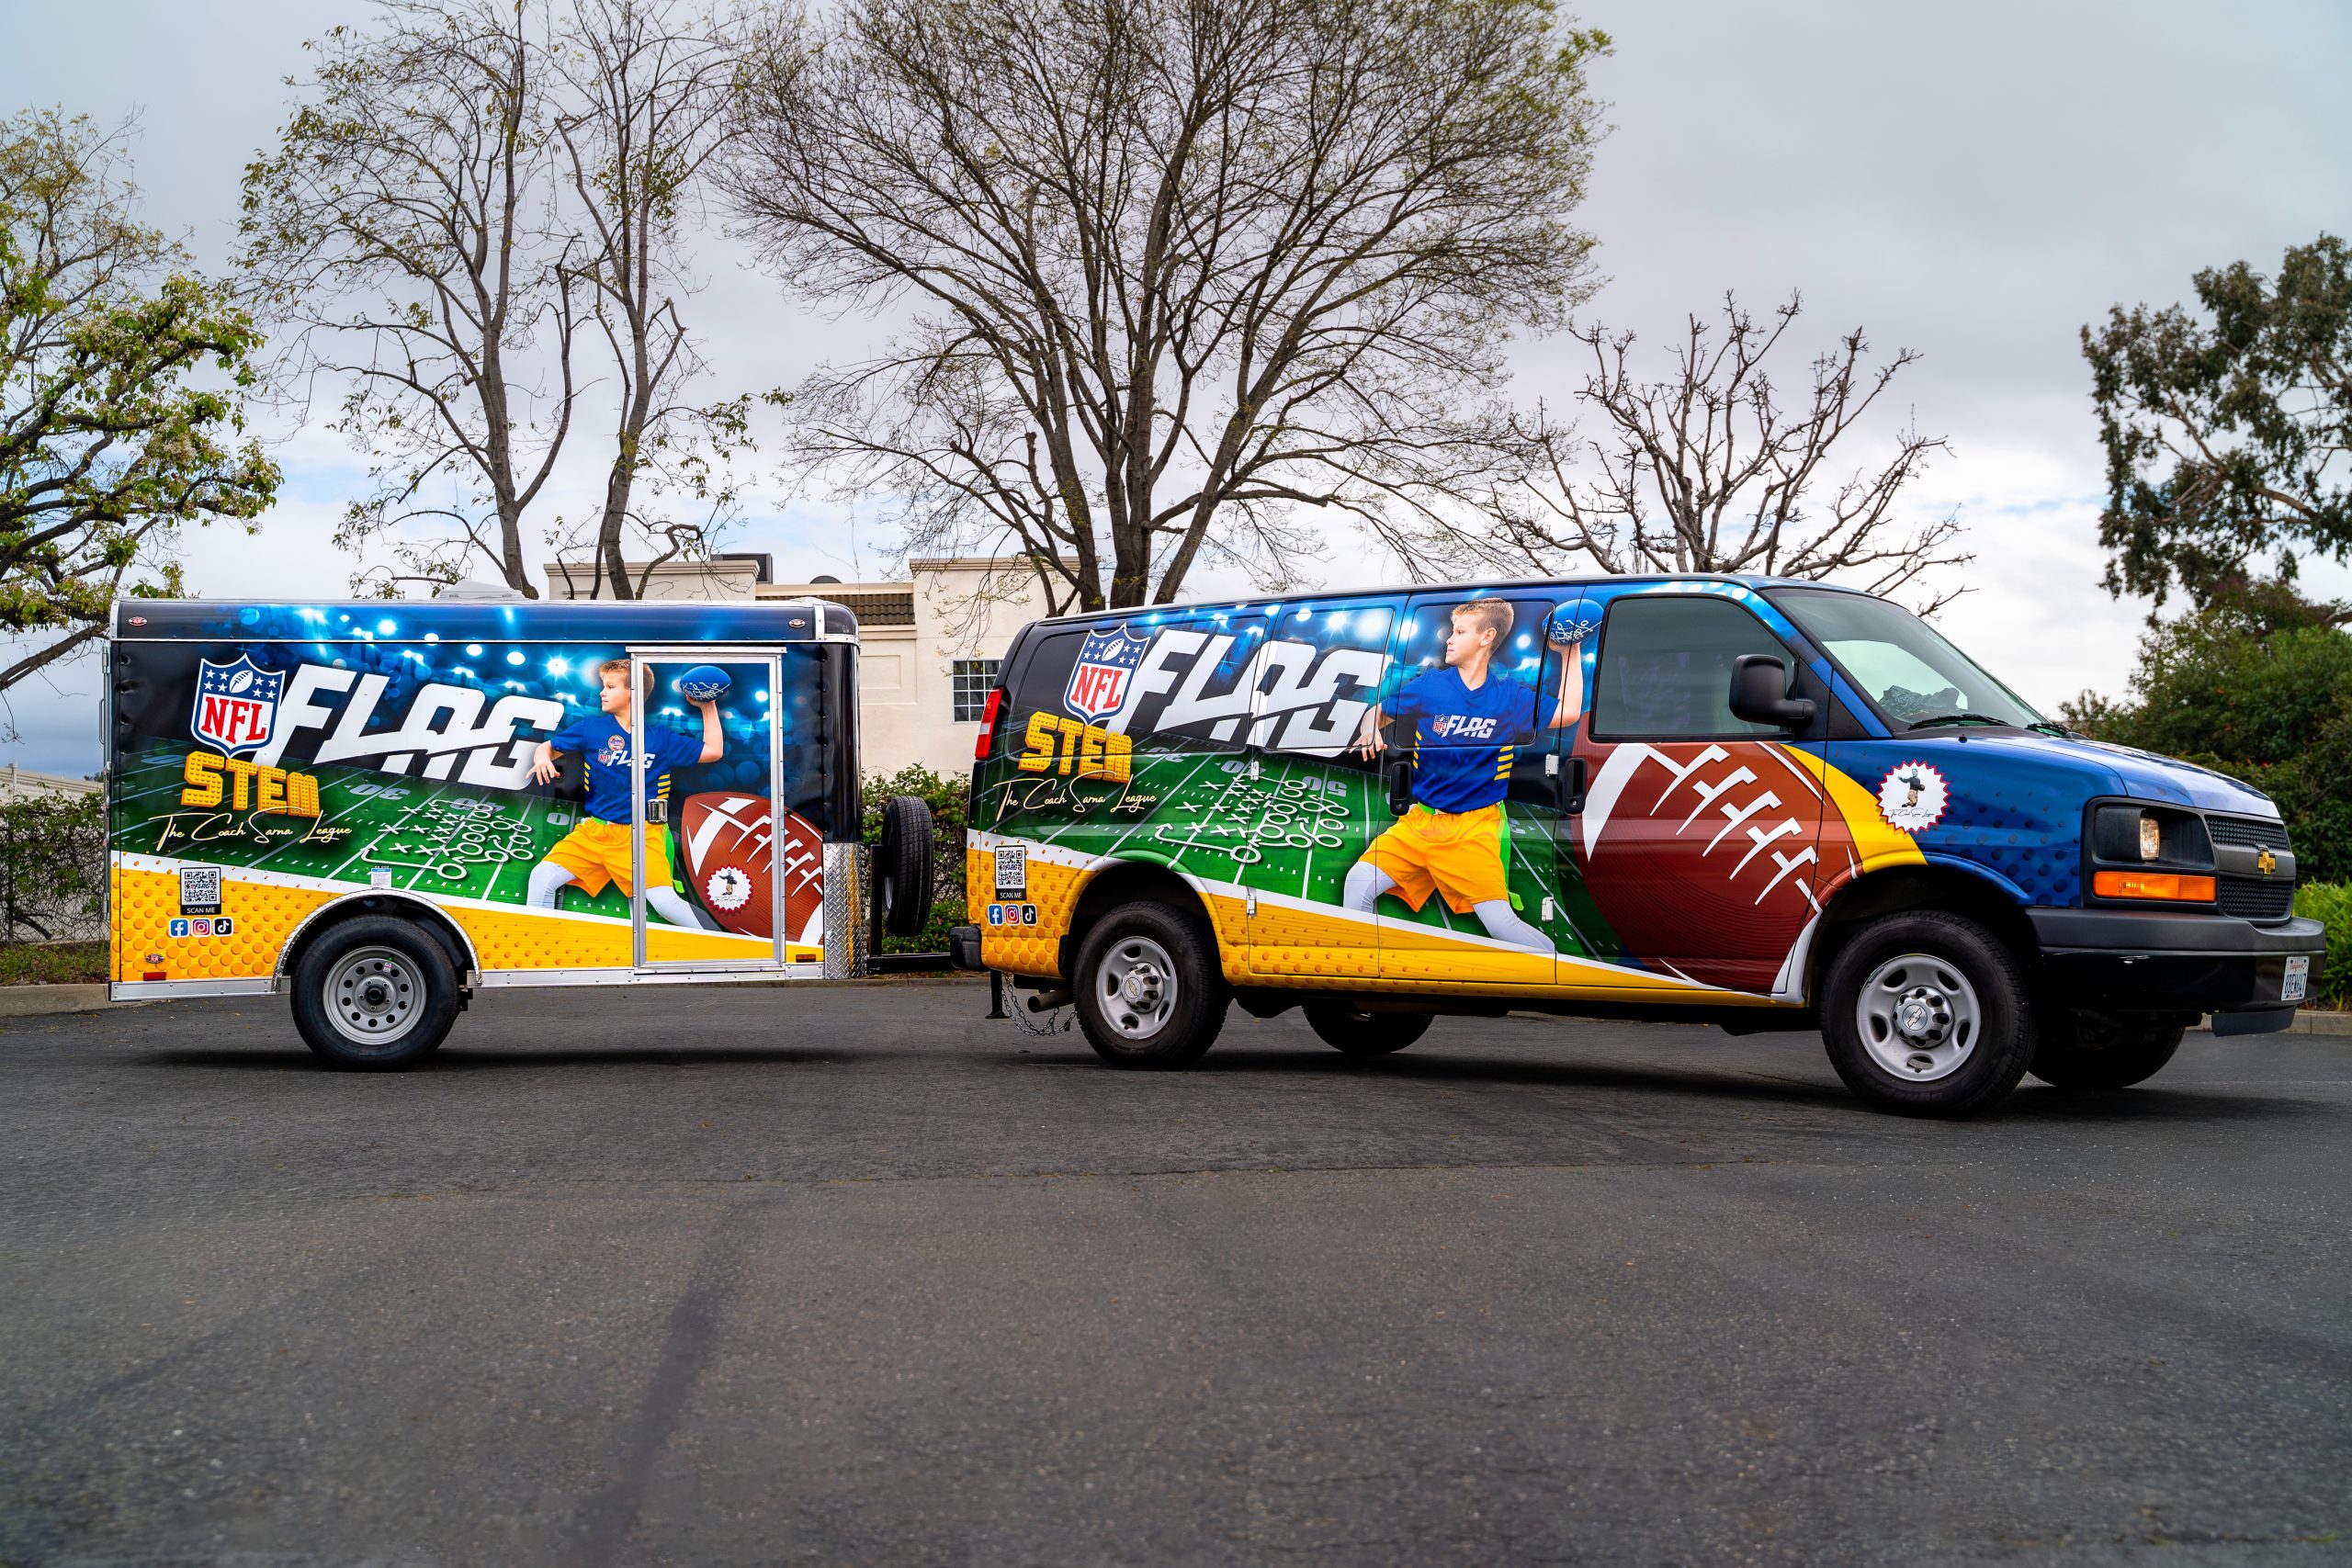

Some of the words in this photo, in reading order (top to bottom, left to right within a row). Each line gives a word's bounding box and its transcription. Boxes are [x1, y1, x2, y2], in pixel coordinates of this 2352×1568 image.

[1071, 665, 1124, 713] NFL
[1105, 629, 1390, 758] FLAG
[201, 696, 267, 745] NFL
[252, 663, 565, 791] FLAG
[1018, 711, 1133, 784] STEM
[1434, 722, 1447, 732] NFL
[1441, 715, 1497, 739] FLAG
[181, 750, 320, 818] STEM
[606, 750, 656, 769] FLG
[993, 778, 1045, 822] The
[1023, 778, 1068, 810] Coach
[1110, 773, 1157, 813] League
[148, 812, 217, 852] The
[191, 812, 247, 840] Coach
[299, 809, 353, 843] League
